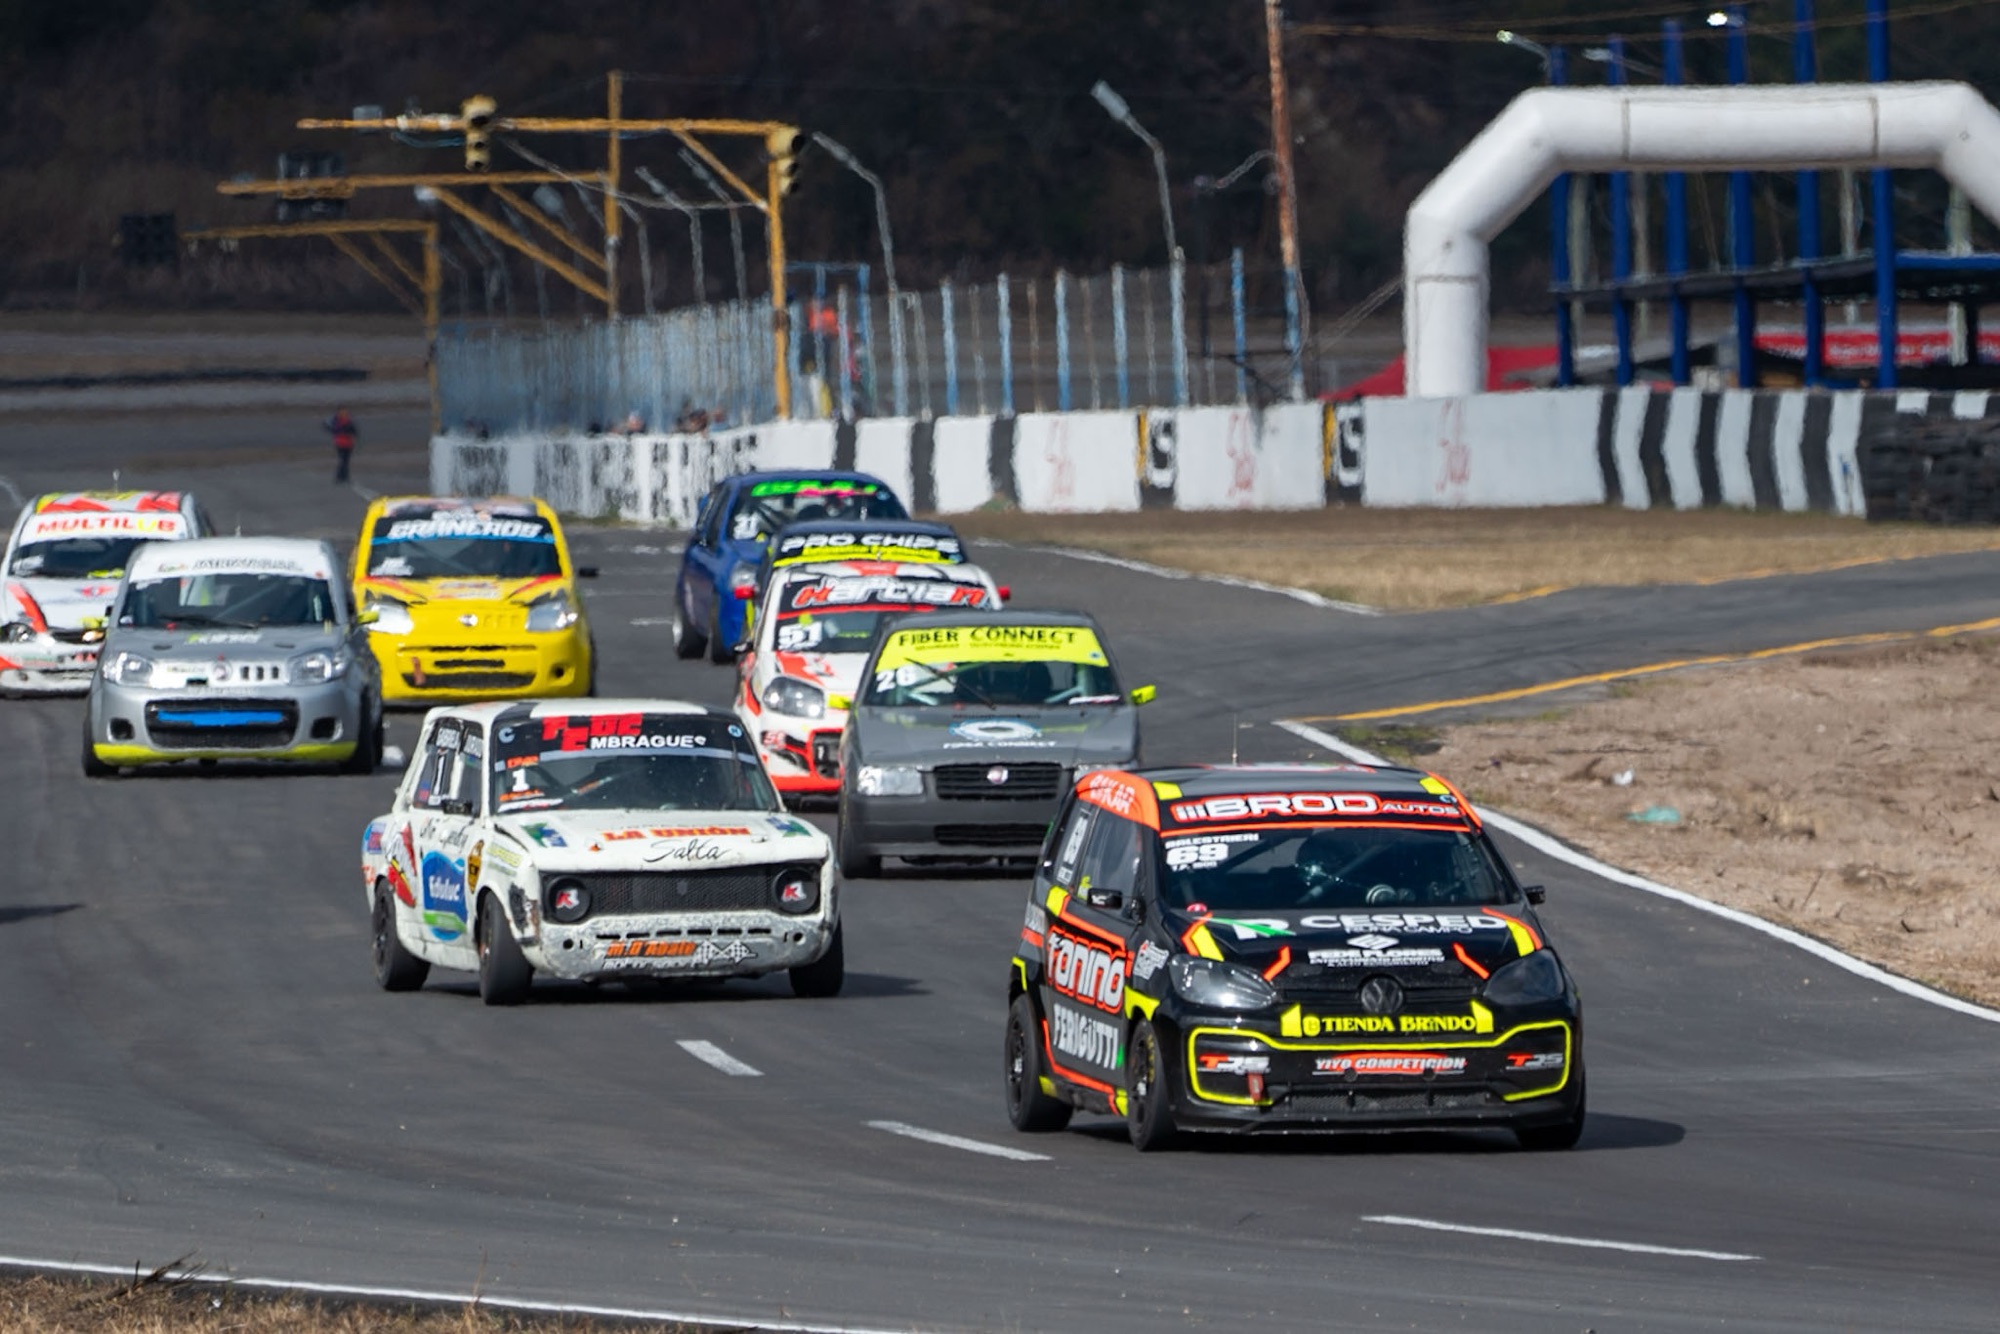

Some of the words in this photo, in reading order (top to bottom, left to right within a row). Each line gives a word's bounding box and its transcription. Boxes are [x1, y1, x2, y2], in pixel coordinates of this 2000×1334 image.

[36, 517, 176, 535] MULTILUB
[782, 533, 856, 552] PRO
[861, 533, 960, 553] CHIPS
[778, 622, 822, 649] 51
[900, 630, 958, 646] FIBER
[970, 628, 1077, 643] CONNECT
[876, 667, 917, 693] 26
[512, 768, 530, 792] 1
[1382, 802, 1460, 815] AUTOS
[603, 828, 646, 840] LA
[643, 838, 732, 863] Salta
[1167, 843, 1229, 866] 69
[1300, 914, 1507, 929] CESPED
[1322, 1016, 1395, 1032] TIENDA
[1399, 1015, 1476, 1032] BRINDO
